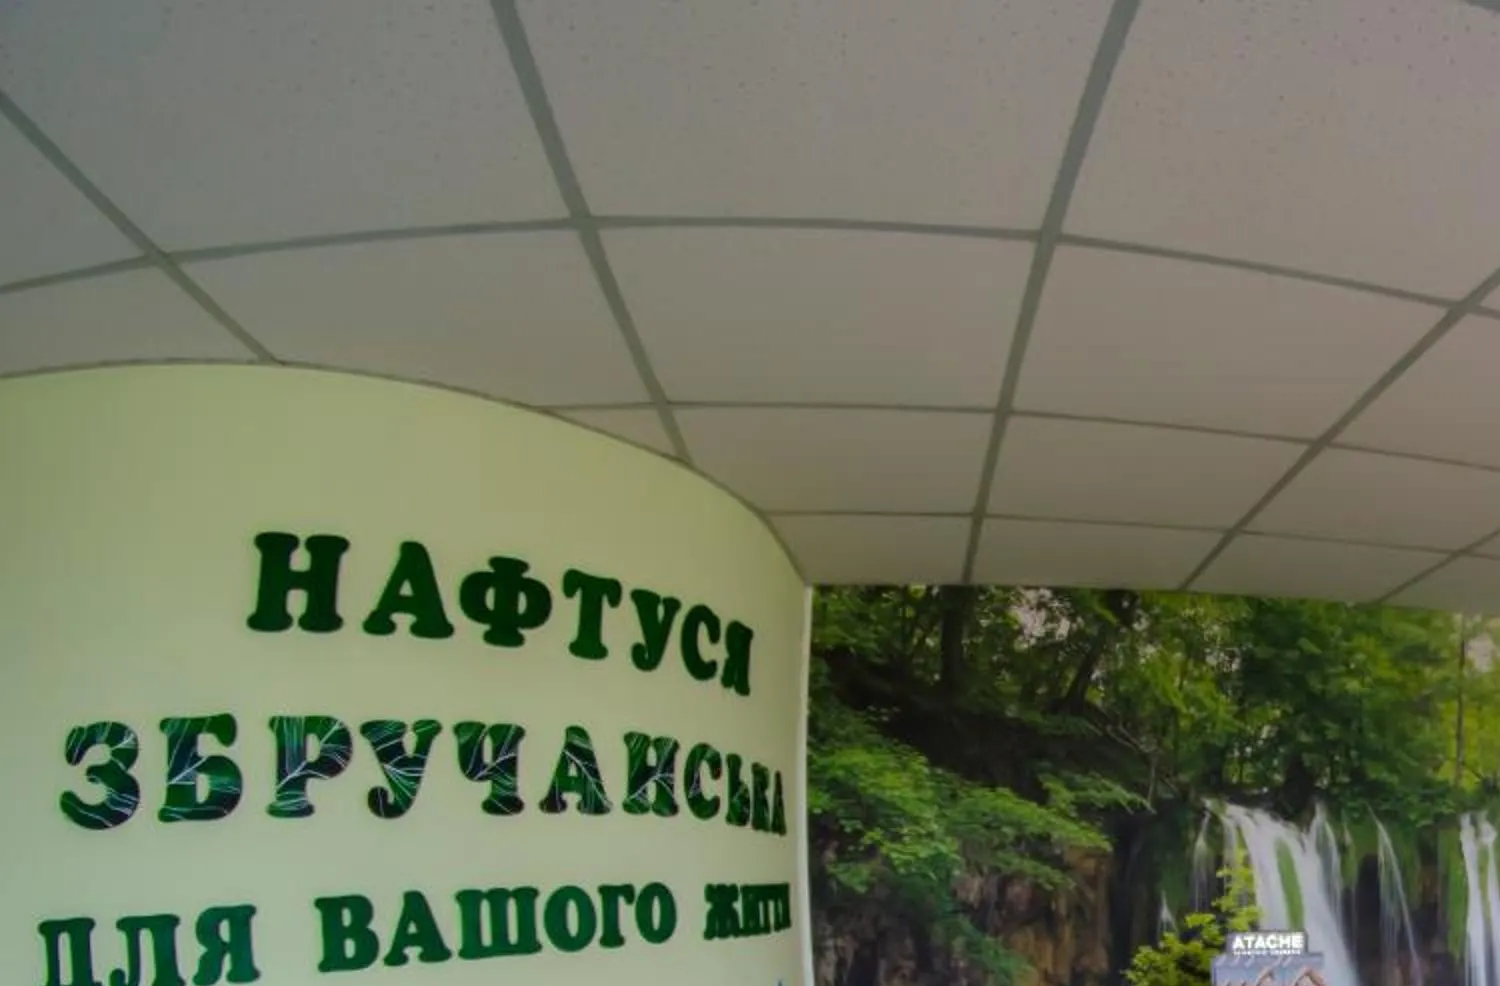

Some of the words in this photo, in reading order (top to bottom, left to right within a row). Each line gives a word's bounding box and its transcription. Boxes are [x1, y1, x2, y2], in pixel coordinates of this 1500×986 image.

[246, 531, 755, 697] НАФТУСЯ
[59, 712, 788, 837] ЗБРУЧАНСЬКА
[313, 881, 678, 973] ВАШОГО
[1232, 933, 1304, 949] ATACHE
